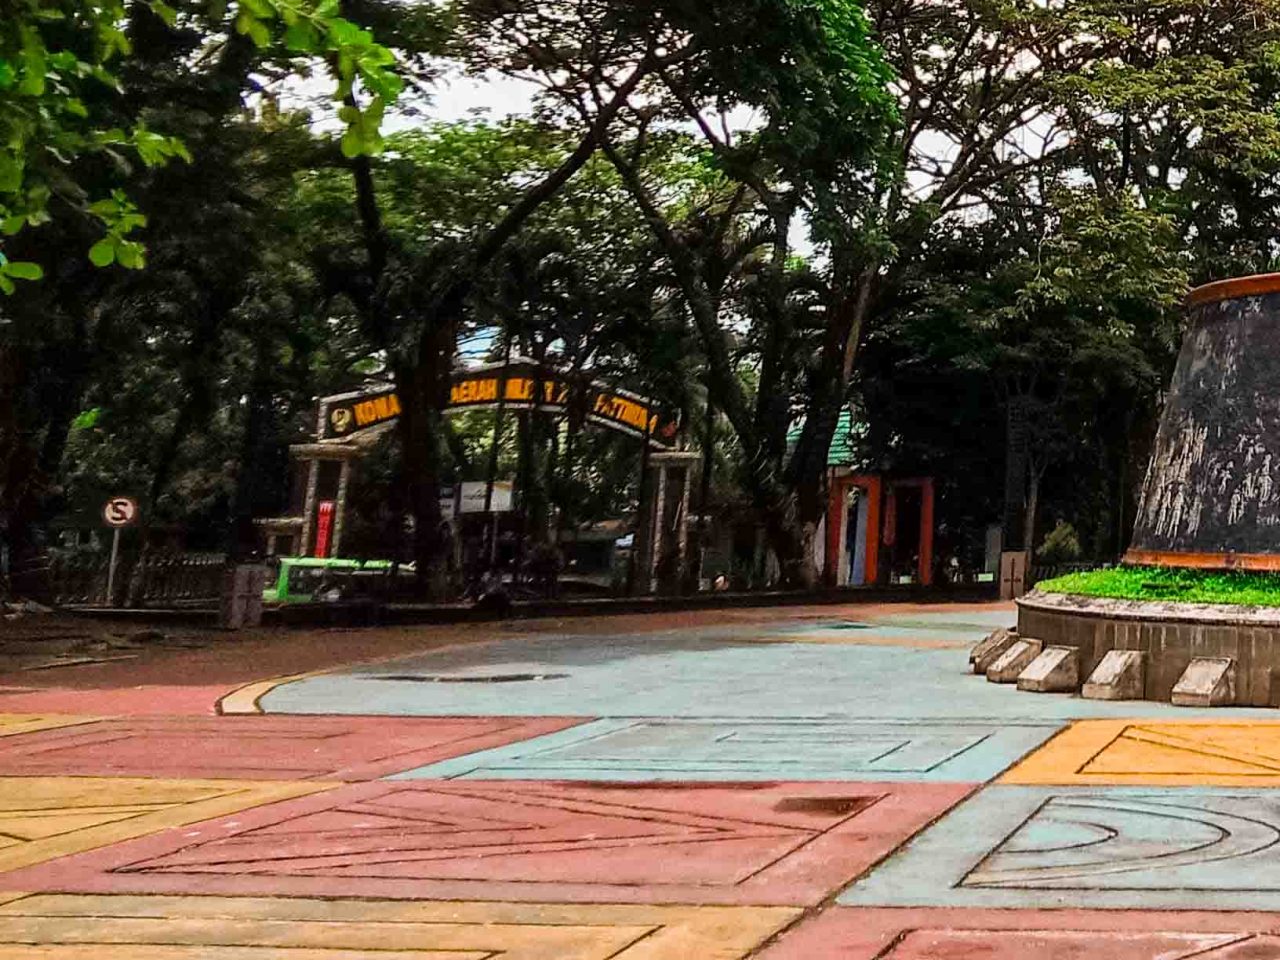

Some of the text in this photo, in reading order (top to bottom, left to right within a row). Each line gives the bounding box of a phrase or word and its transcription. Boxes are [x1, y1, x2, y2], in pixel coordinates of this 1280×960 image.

[353, 394, 401, 426] KOMA
[450, 378, 498, 403] AERAH
[111, 501, 128, 521] S
